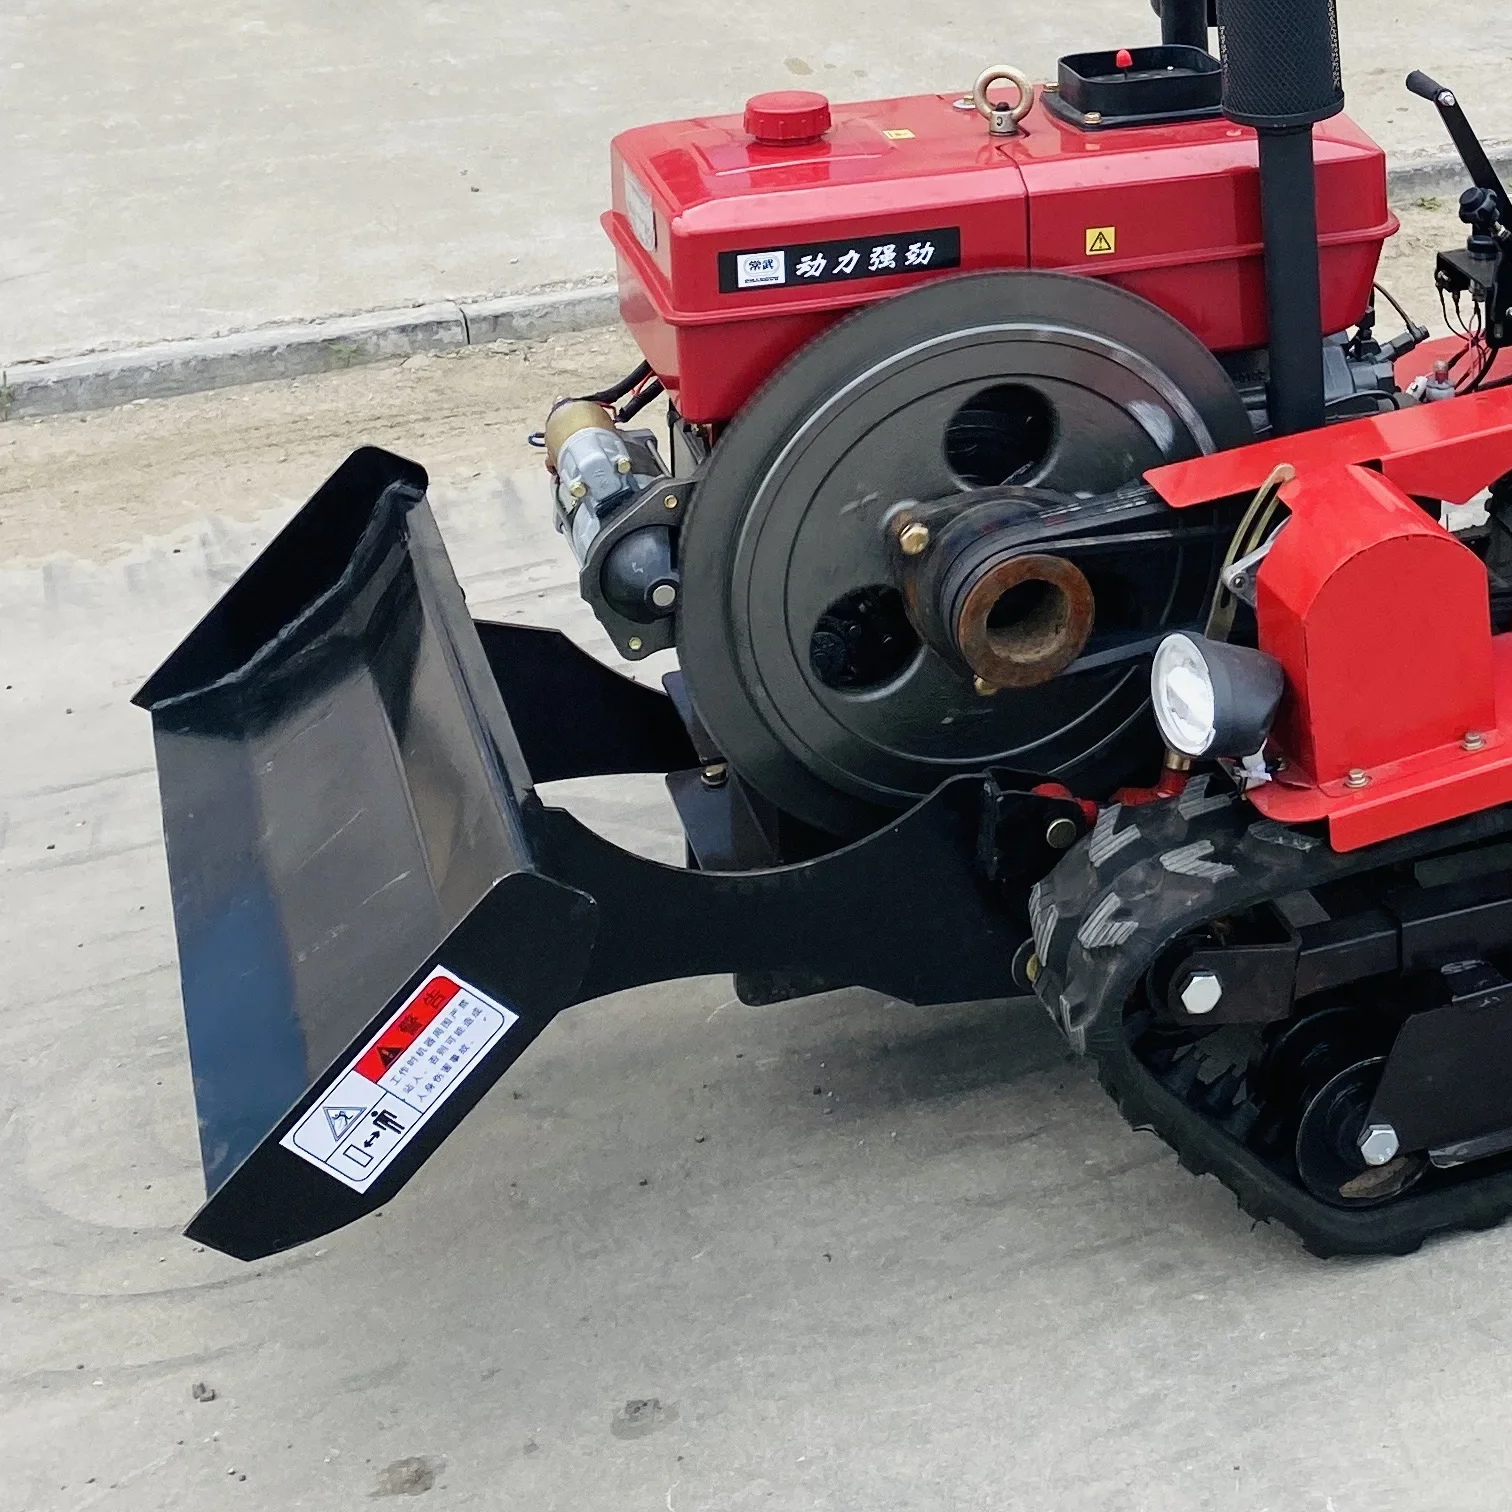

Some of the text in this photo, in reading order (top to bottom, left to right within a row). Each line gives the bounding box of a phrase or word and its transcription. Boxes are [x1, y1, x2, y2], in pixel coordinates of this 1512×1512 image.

[795, 241, 936, 278] 动力强劲
[398, 989, 445, 1036] 警告
